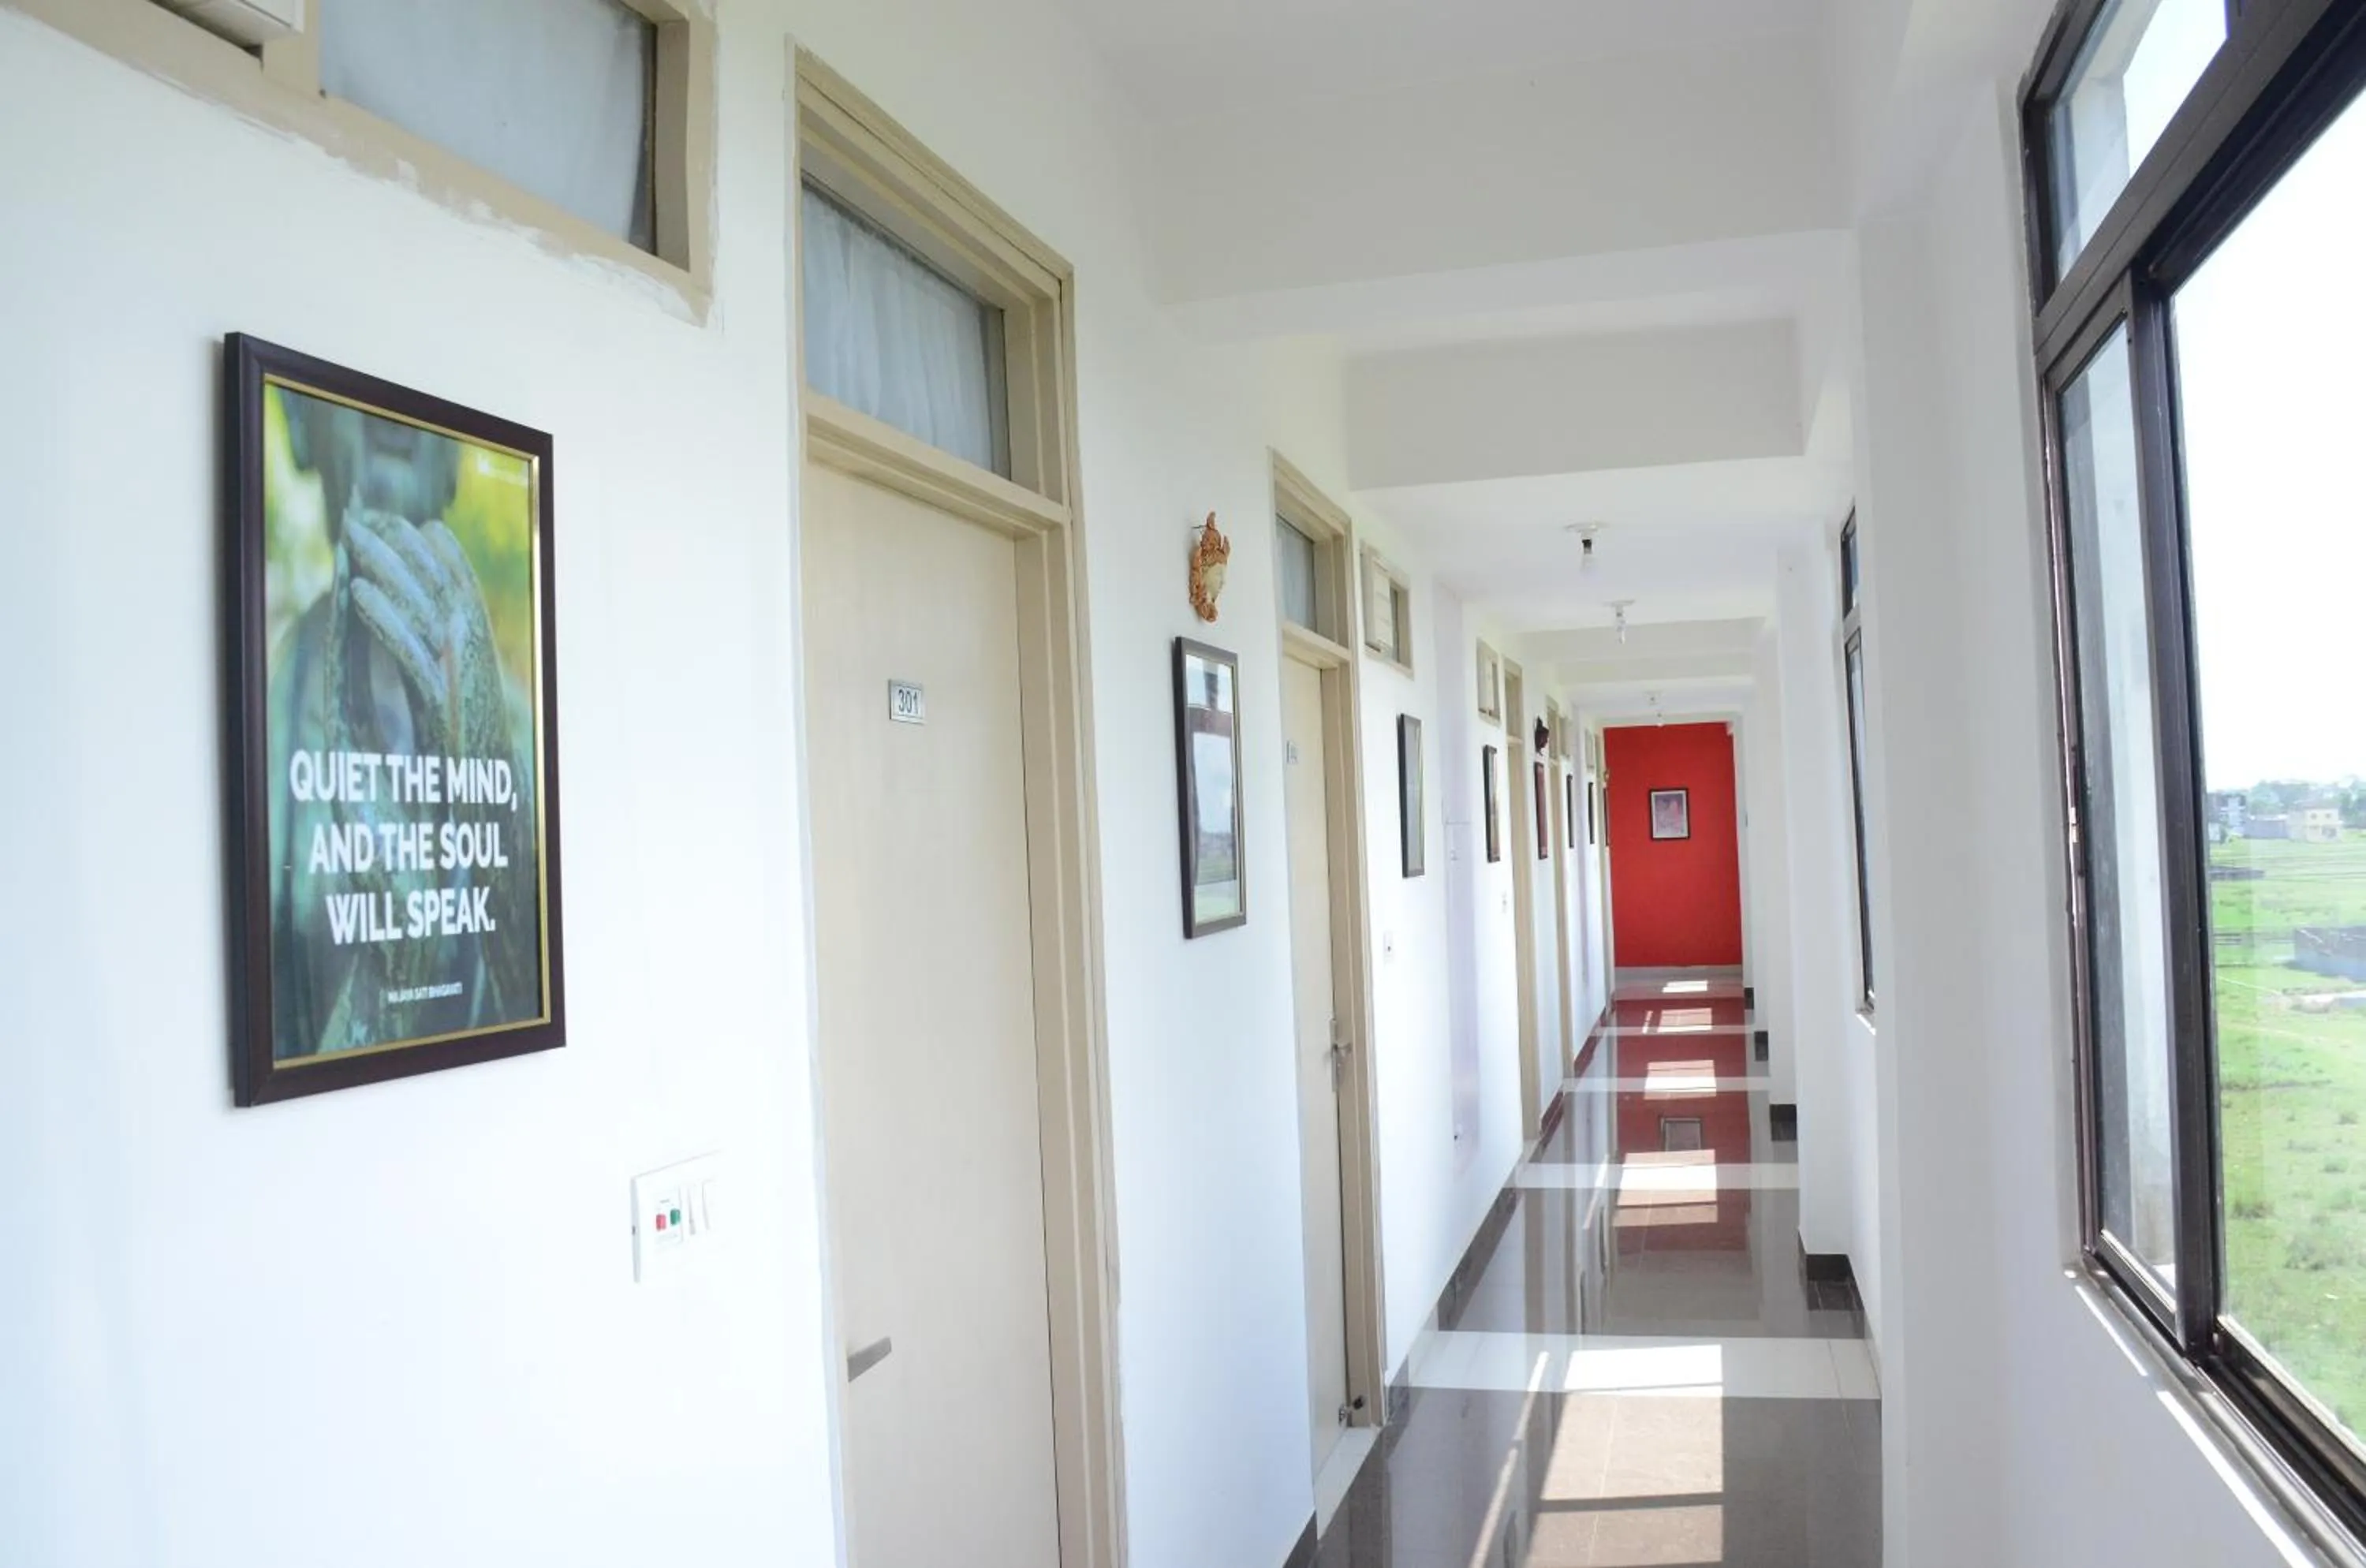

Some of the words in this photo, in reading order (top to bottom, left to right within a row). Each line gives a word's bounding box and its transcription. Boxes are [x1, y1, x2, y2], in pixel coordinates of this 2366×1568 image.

[898, 689, 919, 715] 301
[290, 750, 382, 803] QUIET
[386, 753, 441, 804] THE
[447, 756, 517, 812] MIND,
[309, 823, 375, 874] AND
[378, 823, 435, 872] THE
[439, 823, 509, 868] SOUL
[326, 892, 402, 946] WILL
[406, 887, 496, 938] SPEAK.
